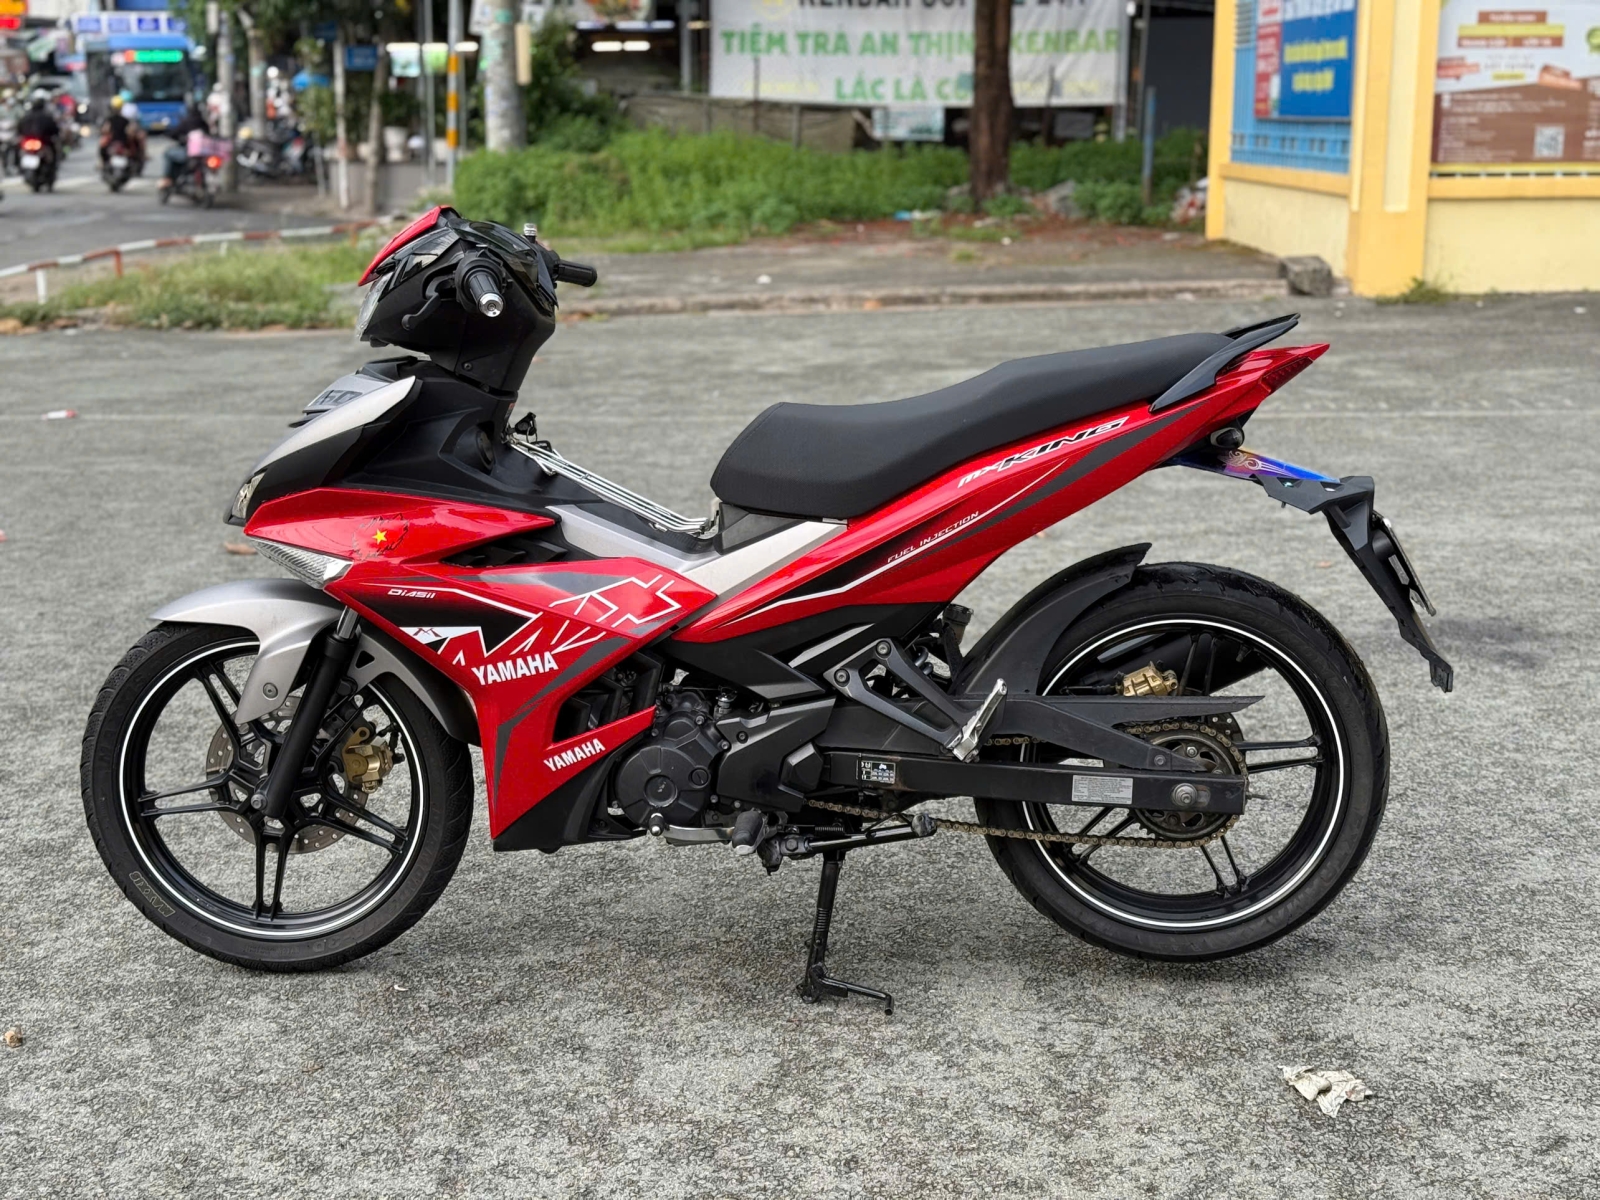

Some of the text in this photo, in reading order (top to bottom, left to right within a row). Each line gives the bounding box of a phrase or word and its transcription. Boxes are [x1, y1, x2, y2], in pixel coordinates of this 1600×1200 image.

[859, 31, 899, 55] AN
[887, 511, 979, 563] FUEL INJECTION
[471, 651, 559, 686] YAMAHA
[543, 738, 606, 772] YAMAHA
[128, 870, 176, 918] MAXXIS
